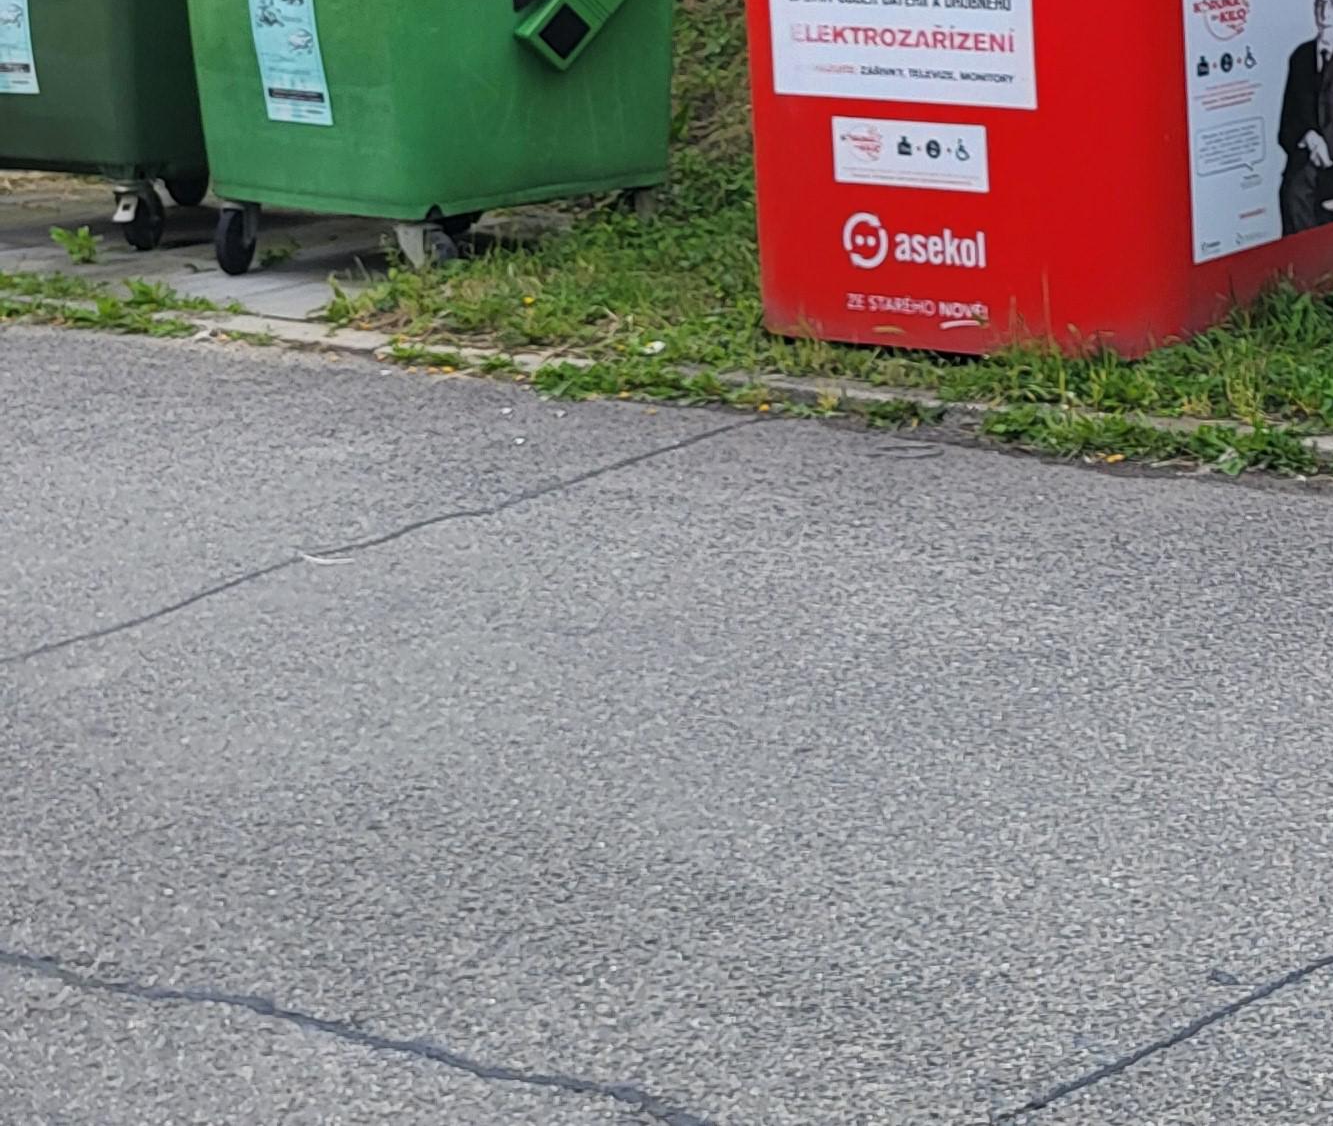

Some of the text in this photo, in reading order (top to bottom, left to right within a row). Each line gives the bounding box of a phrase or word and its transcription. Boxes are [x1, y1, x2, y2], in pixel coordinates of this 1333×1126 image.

[791, 24, 1016, 53] ELEKTROZAŘÍZENÍ
[894, 228, 987, 269] asekol
[846, 292, 866, 311] ZE
[868, 295, 936, 317] STARÉHO
